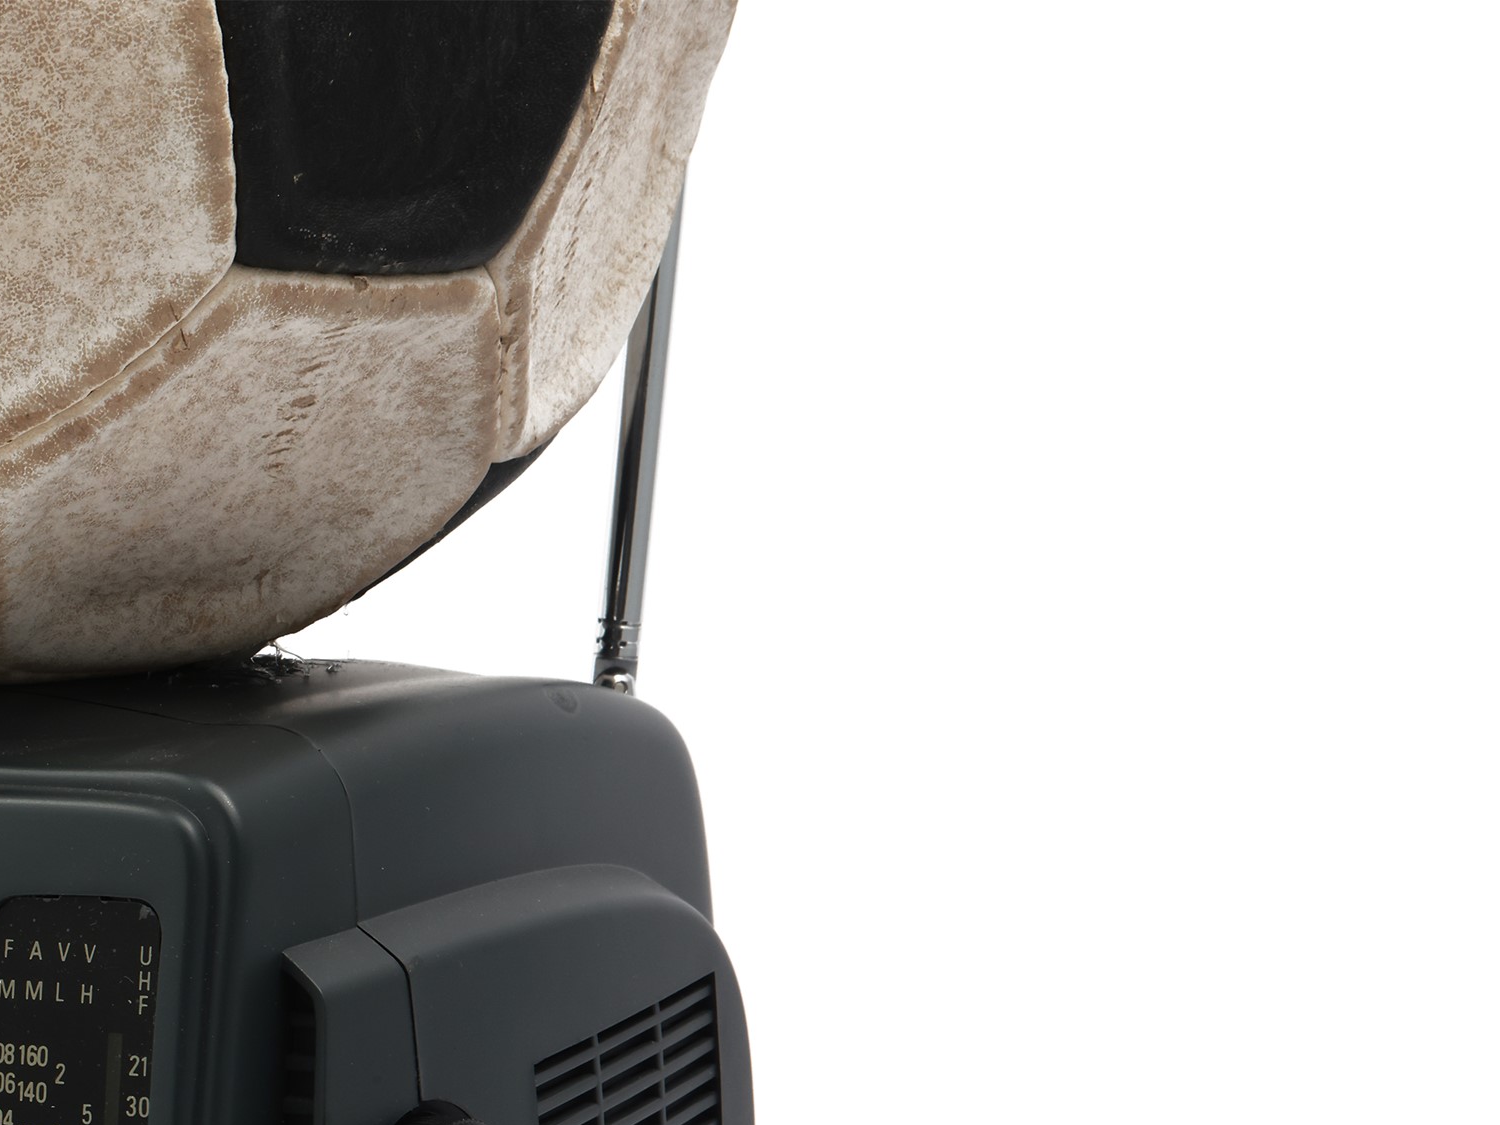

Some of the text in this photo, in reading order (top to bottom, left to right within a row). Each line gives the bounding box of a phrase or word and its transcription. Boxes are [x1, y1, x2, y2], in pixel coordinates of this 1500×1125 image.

[18, 1044, 49, 1067] 160
[128, 1054, 148, 1077] 21
[54, 1063, 66, 1085] 2
[17, 1080, 47, 1104] 140
[81, 1103, 93, 1125] 5
[125, 1095, 150, 1118] 30
